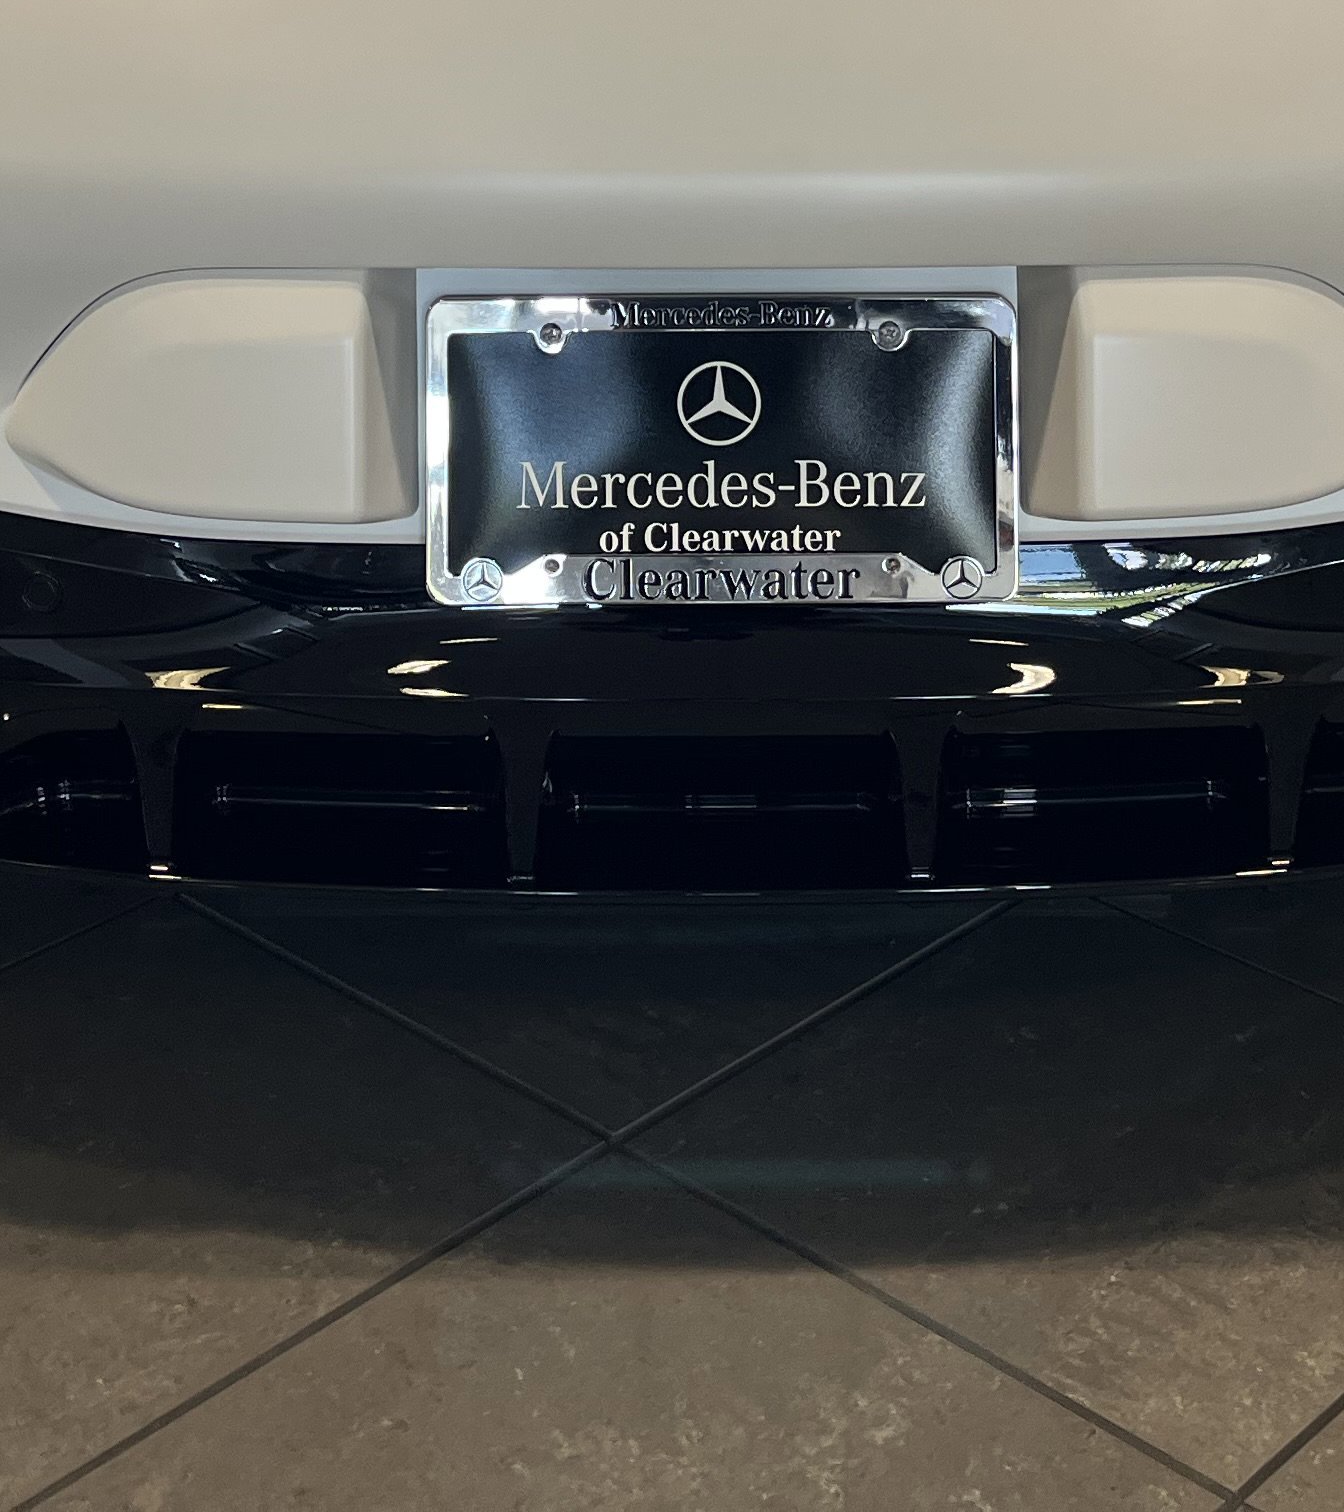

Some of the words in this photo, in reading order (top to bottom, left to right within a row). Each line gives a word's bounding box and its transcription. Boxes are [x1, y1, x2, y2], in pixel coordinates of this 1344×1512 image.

[610, 300, 835, 328] Mercedes-Benz
[516, 459, 927, 509] Mercedes-Benz
[599, 521, 636, 553] of
[644, 522, 842, 552] Clearwater
[583, 558, 861, 601] Clearwater
